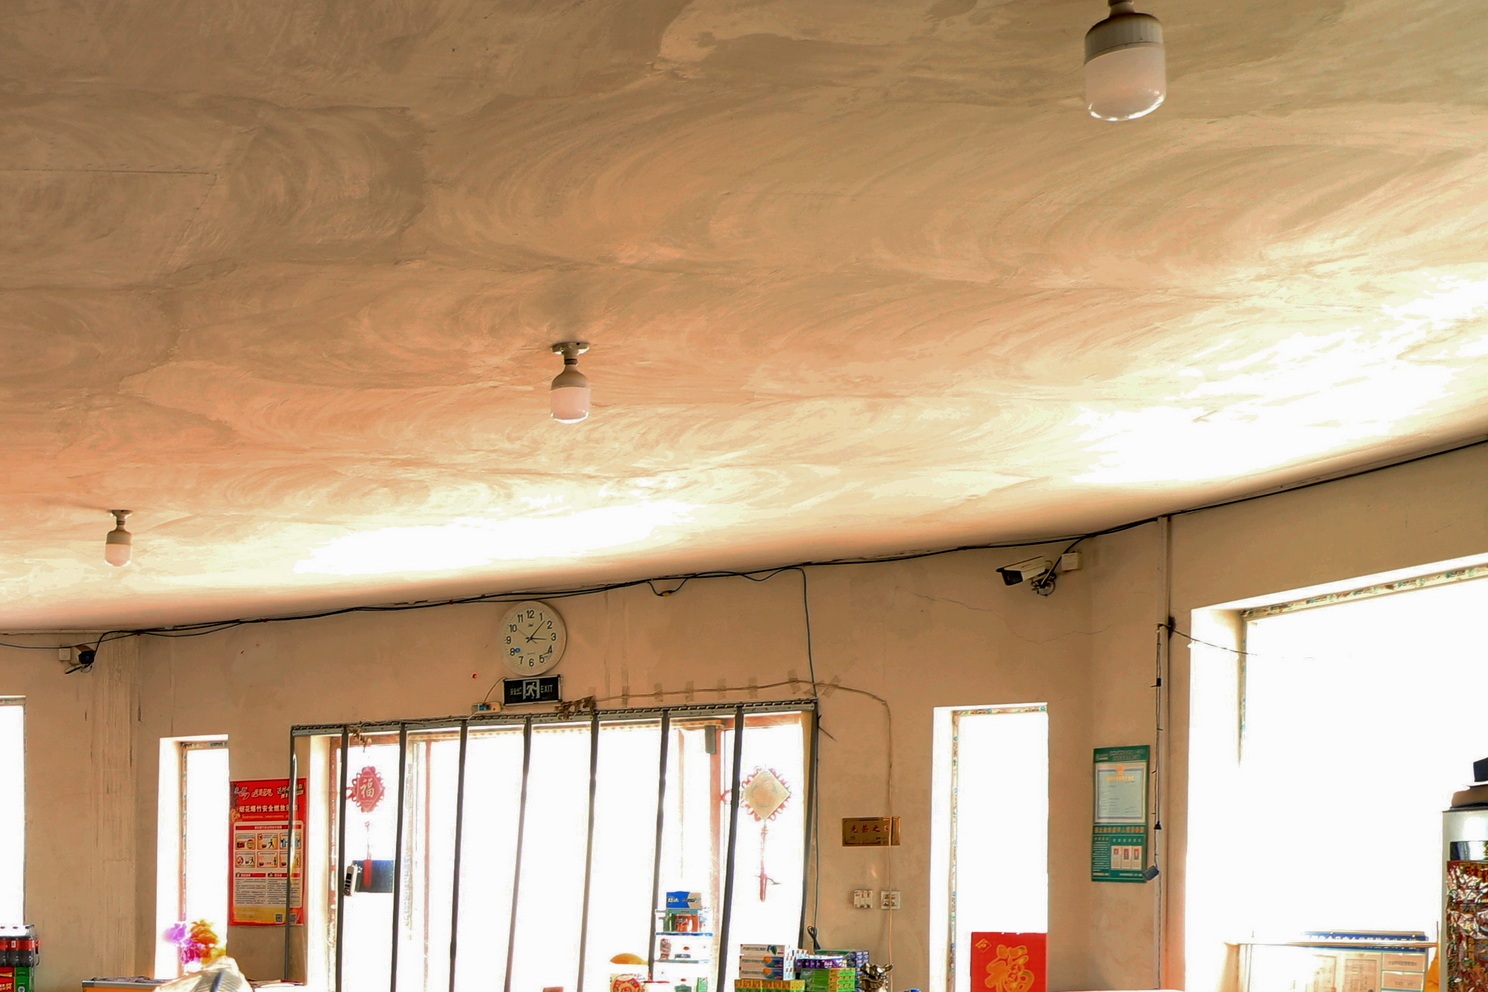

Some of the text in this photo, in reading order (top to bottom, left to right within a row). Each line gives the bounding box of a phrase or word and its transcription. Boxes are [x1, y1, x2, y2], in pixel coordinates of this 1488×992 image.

[517, 614, 524, 623] 11
[526, 610, 535, 619] 12
[508, 624, 518, 633] 10
[547, 621, 553, 630] 2
[506, 636, 512, 645] 9
[550, 633, 557, 641] 3
[509, 647, 515, 656] 8
[547, 645, 553, 654] 4
[518, 655, 524, 665] 7
[528, 658, 535, 667] 6
[539, 654, 545, 663] 5
[540, 684, 554, 693] EXIT
[360, 778, 376, 798] 福
